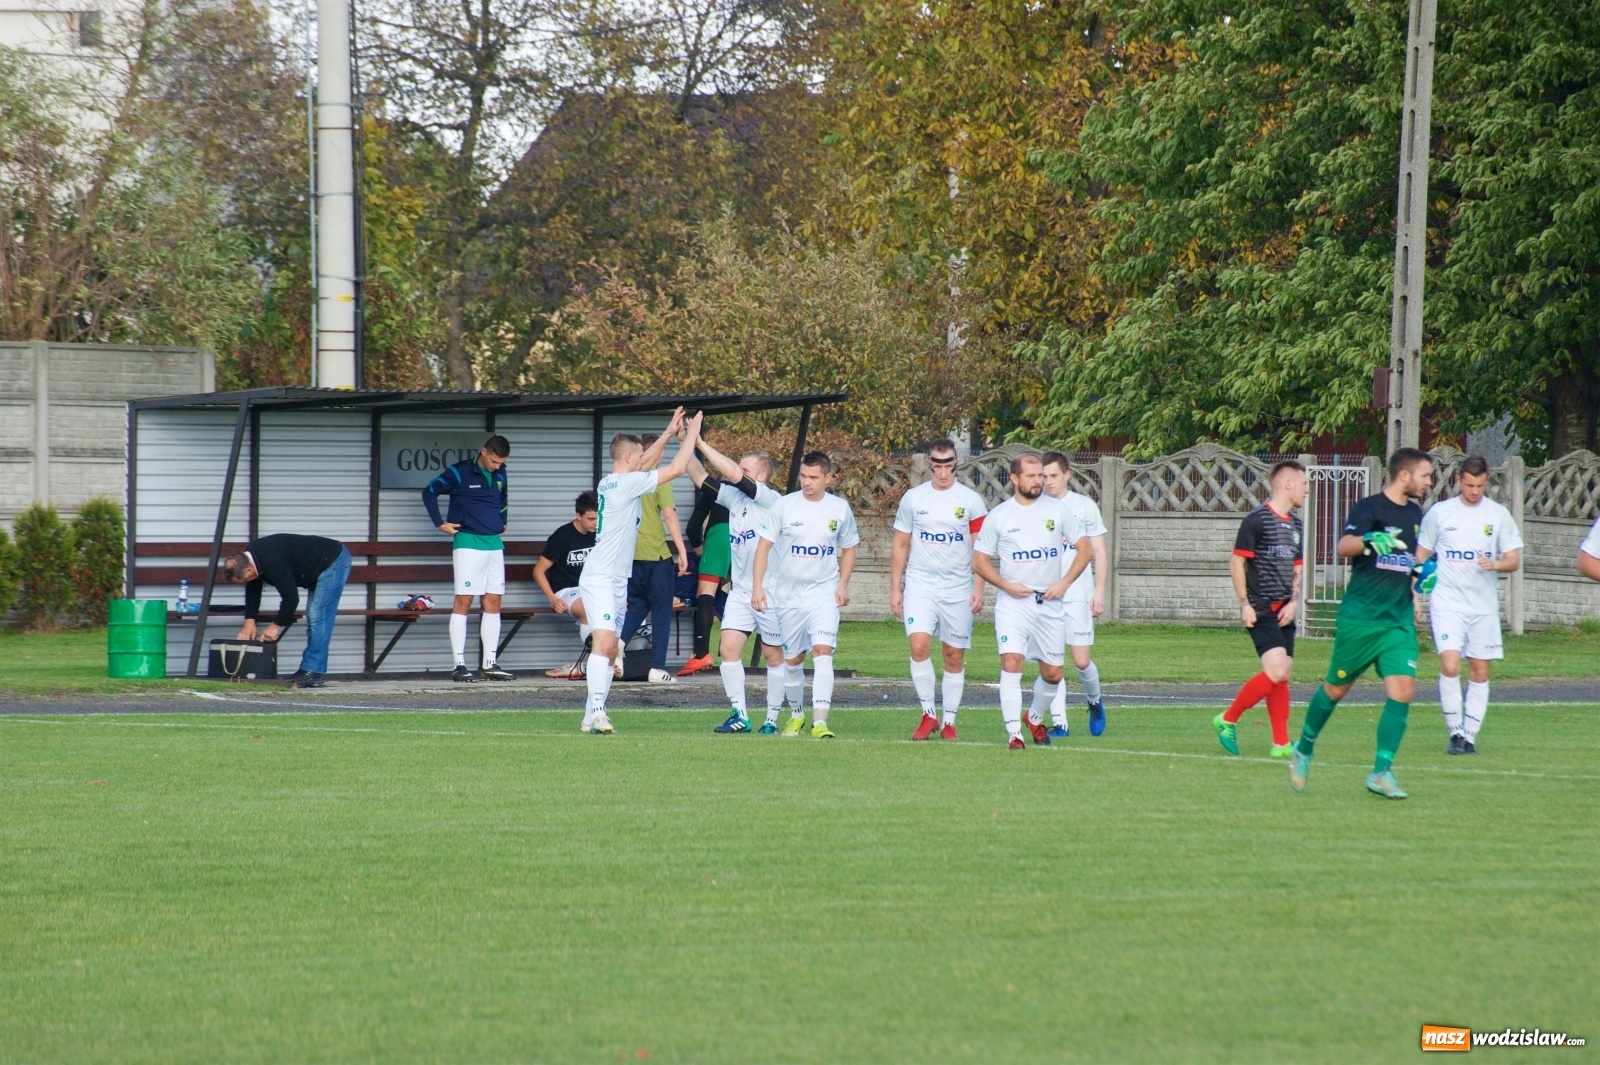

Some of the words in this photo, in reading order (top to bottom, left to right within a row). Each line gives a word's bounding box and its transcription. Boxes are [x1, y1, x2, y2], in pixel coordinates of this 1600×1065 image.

[920, 531, 964, 546] moya
[791, 543, 834, 560] moya
[1012, 546, 1058, 564] moya
